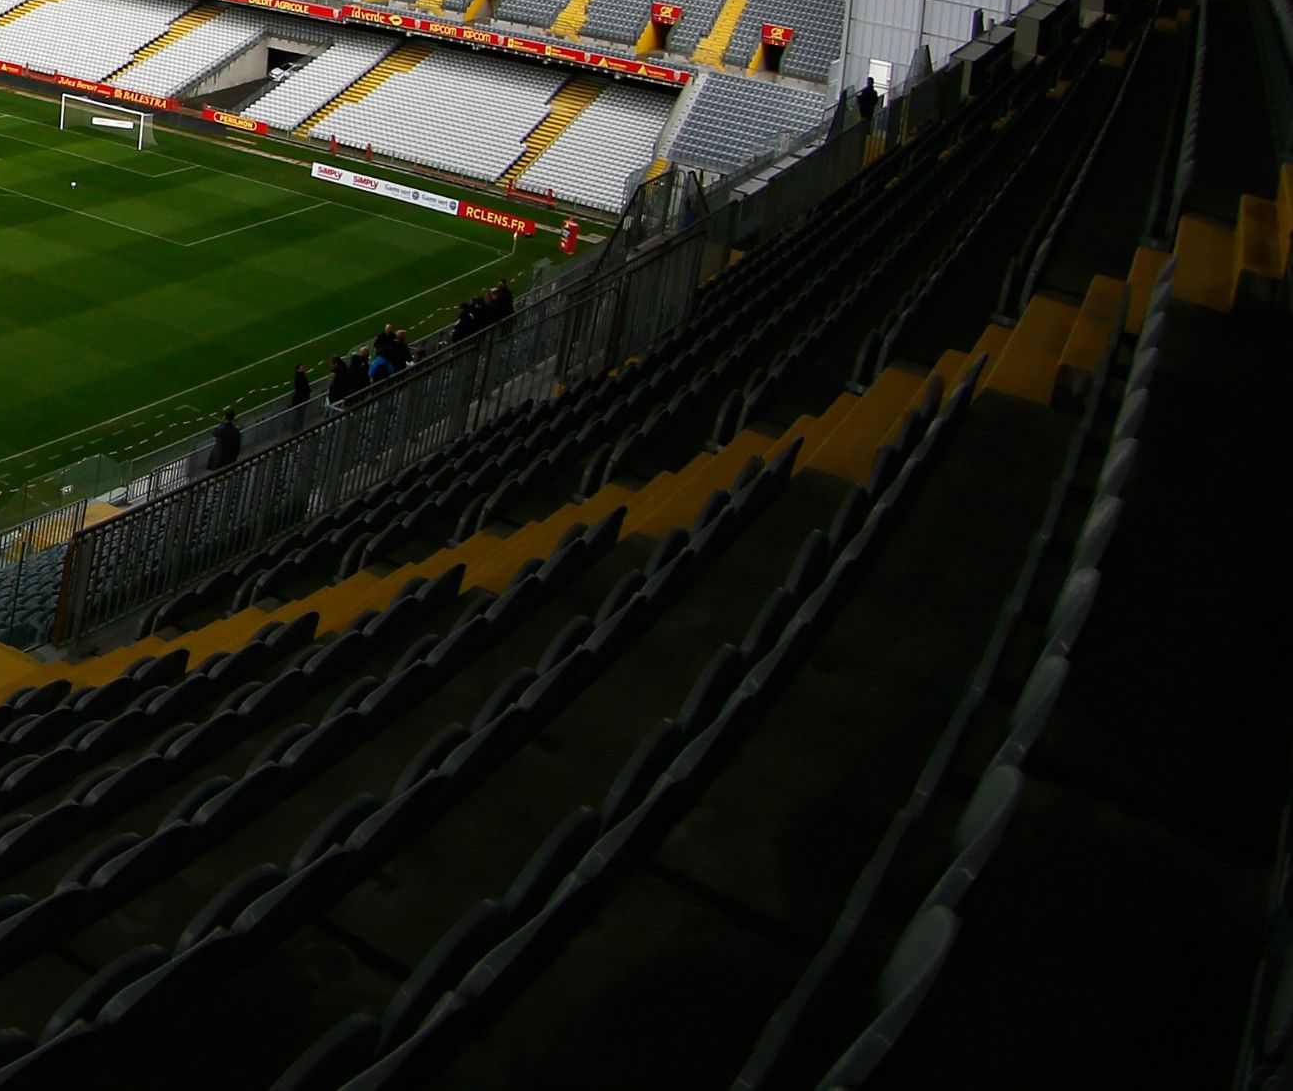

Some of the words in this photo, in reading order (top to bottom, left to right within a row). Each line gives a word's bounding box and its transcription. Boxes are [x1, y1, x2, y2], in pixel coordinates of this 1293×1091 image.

[274, 0, 309, 14] AGRICOLE
[56, 76, 76, 88] Jules
[123, 90, 167, 109] BALESTRA
[466, 206, 526, 232] RCLENS.FR
